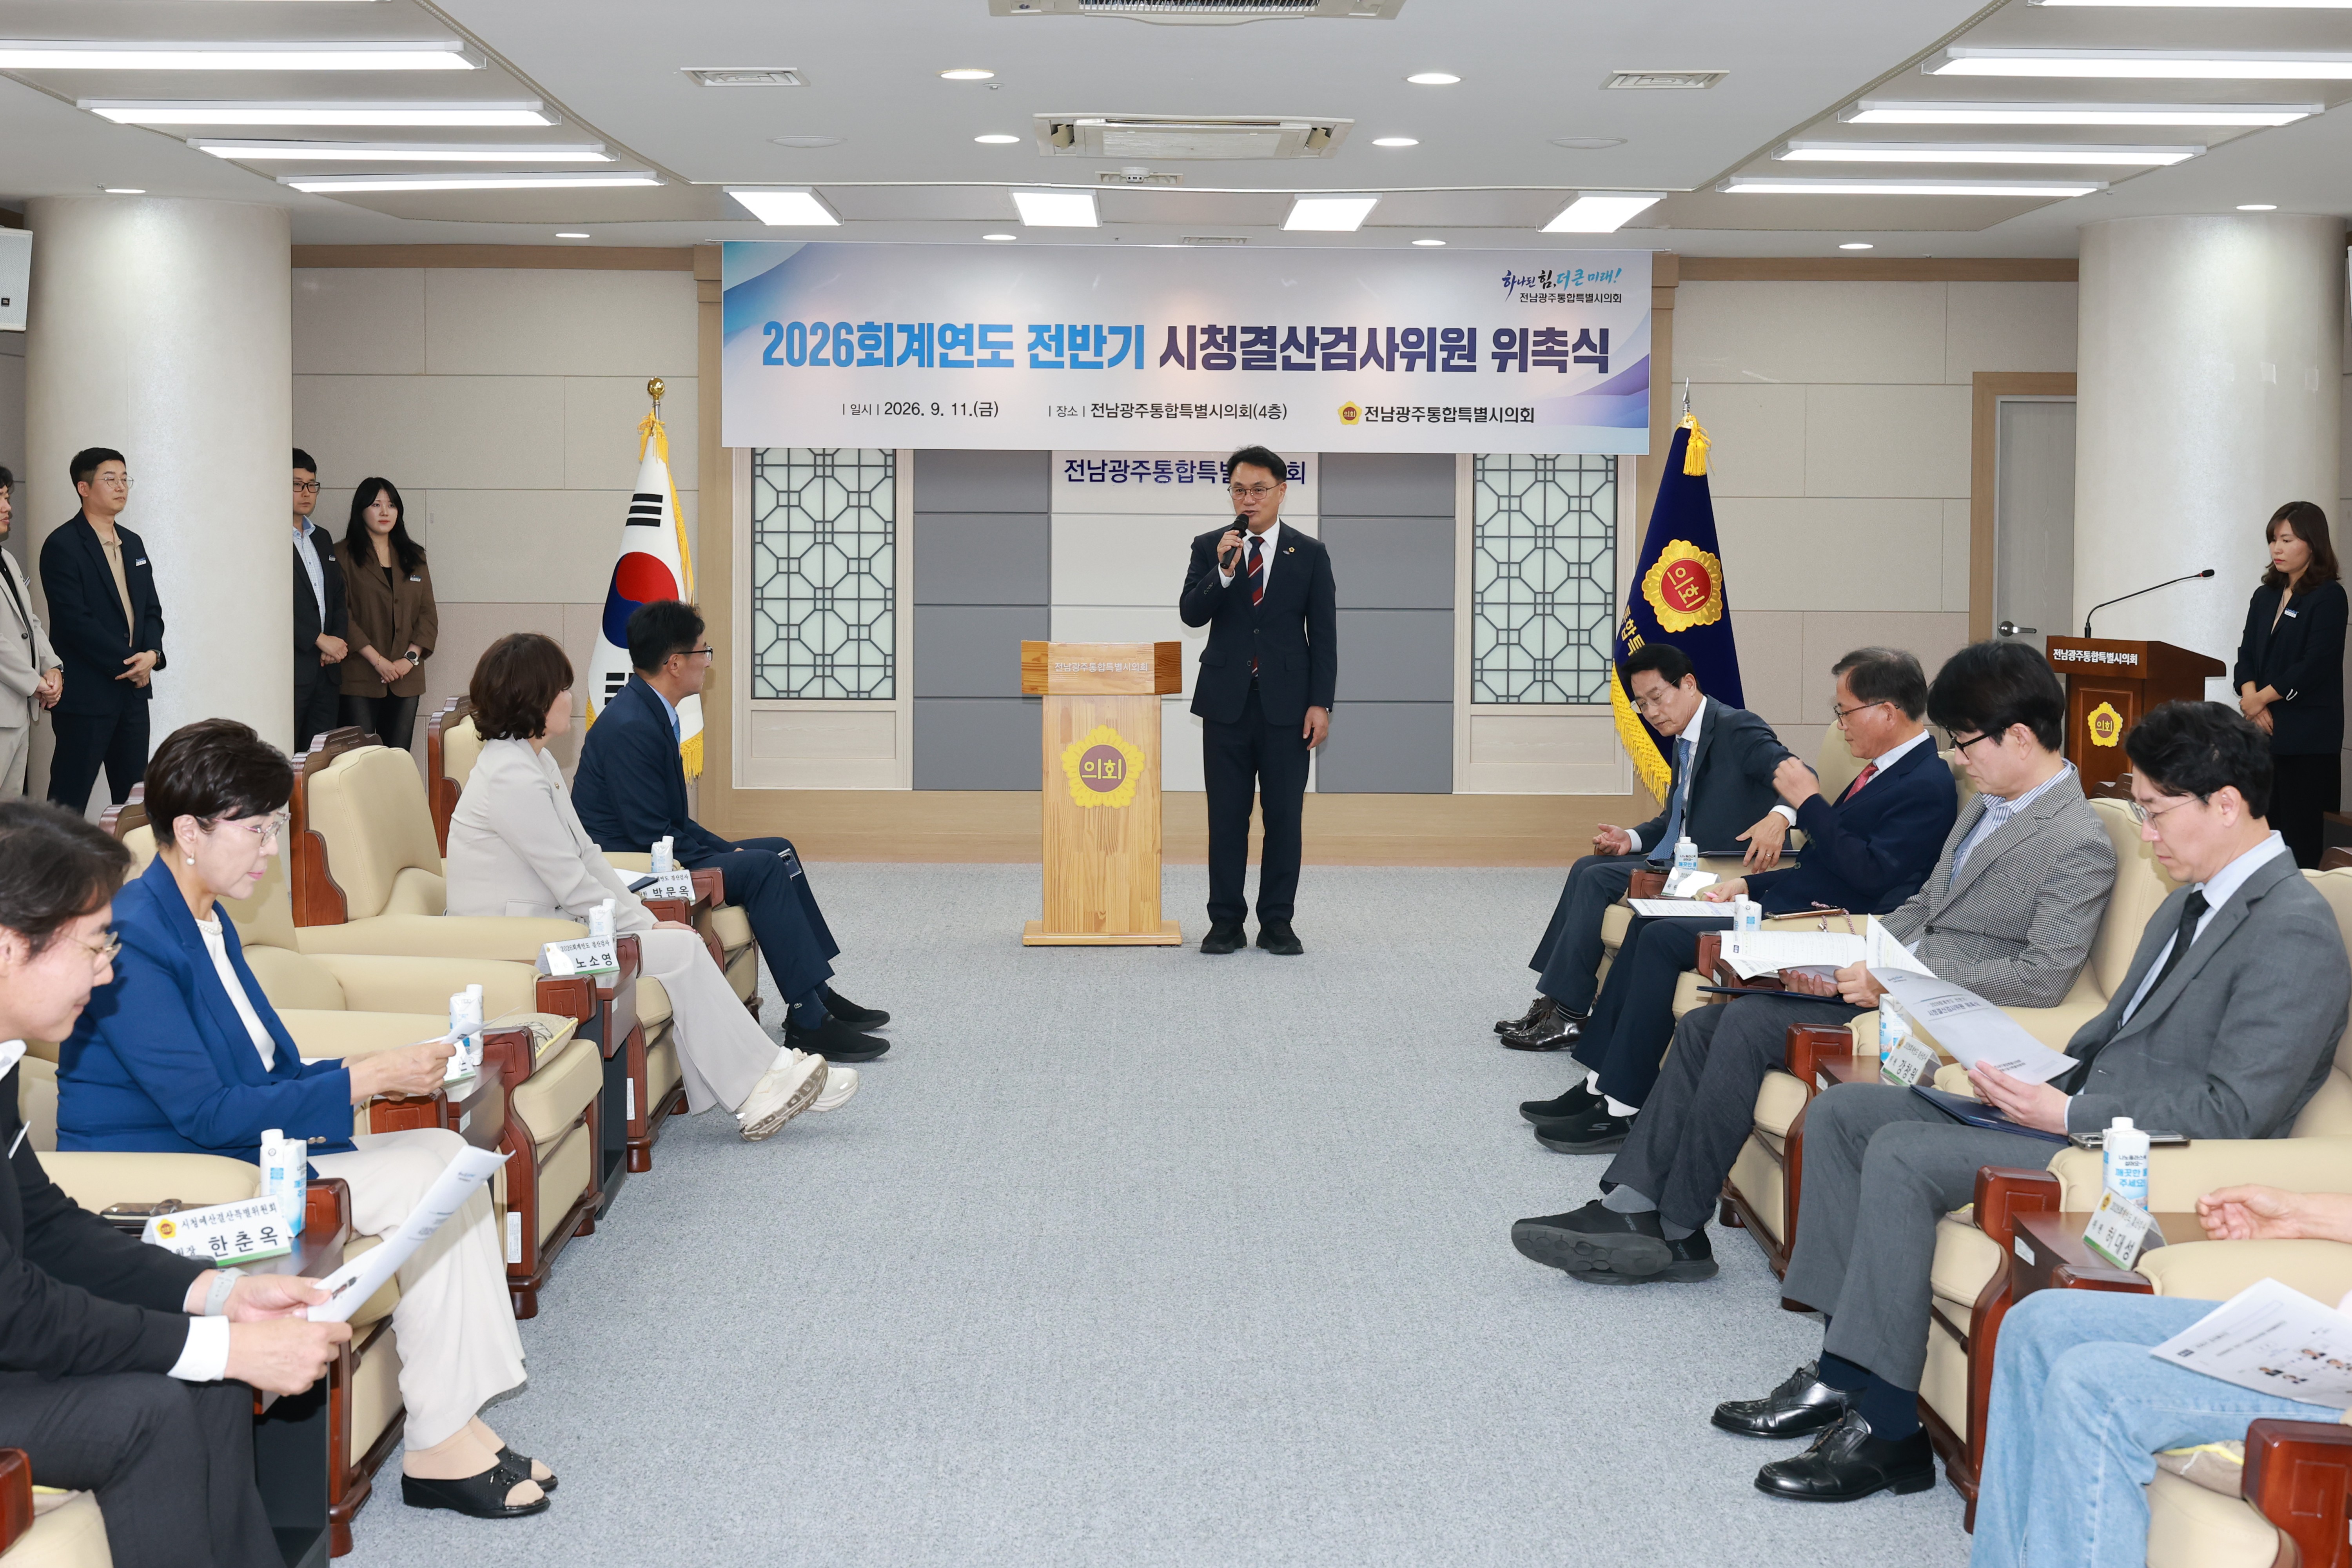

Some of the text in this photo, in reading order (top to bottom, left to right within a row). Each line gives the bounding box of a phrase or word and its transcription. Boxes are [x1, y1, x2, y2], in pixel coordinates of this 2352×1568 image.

[1502, 268, 1622, 302] 하나된 힘, 더 큰 미래!
[1520, 293, 1622, 303] 전남광주통합특별시의회
[762, 321, 1610, 374] 2026회계연도 전반기 시청결산검사위원 위촉식
[850, 401, 999, 418] 일시 2026. 9. 11.(금)
[1056, 403, 1288, 421] 장소 전남광주통합특별시의회(4층)
[1364, 406, 1534, 423] 전남광주통합특별시의회
[1667, 566, 1705, 608] 의회
[2053, 648, 2138, 666] 전남광주통합특별시의회
[1055, 662, 1148, 673] 전남광주통합특별시의회
[2096, 720, 2112, 732] 의회
[1082, 758, 1122, 780] 의회
